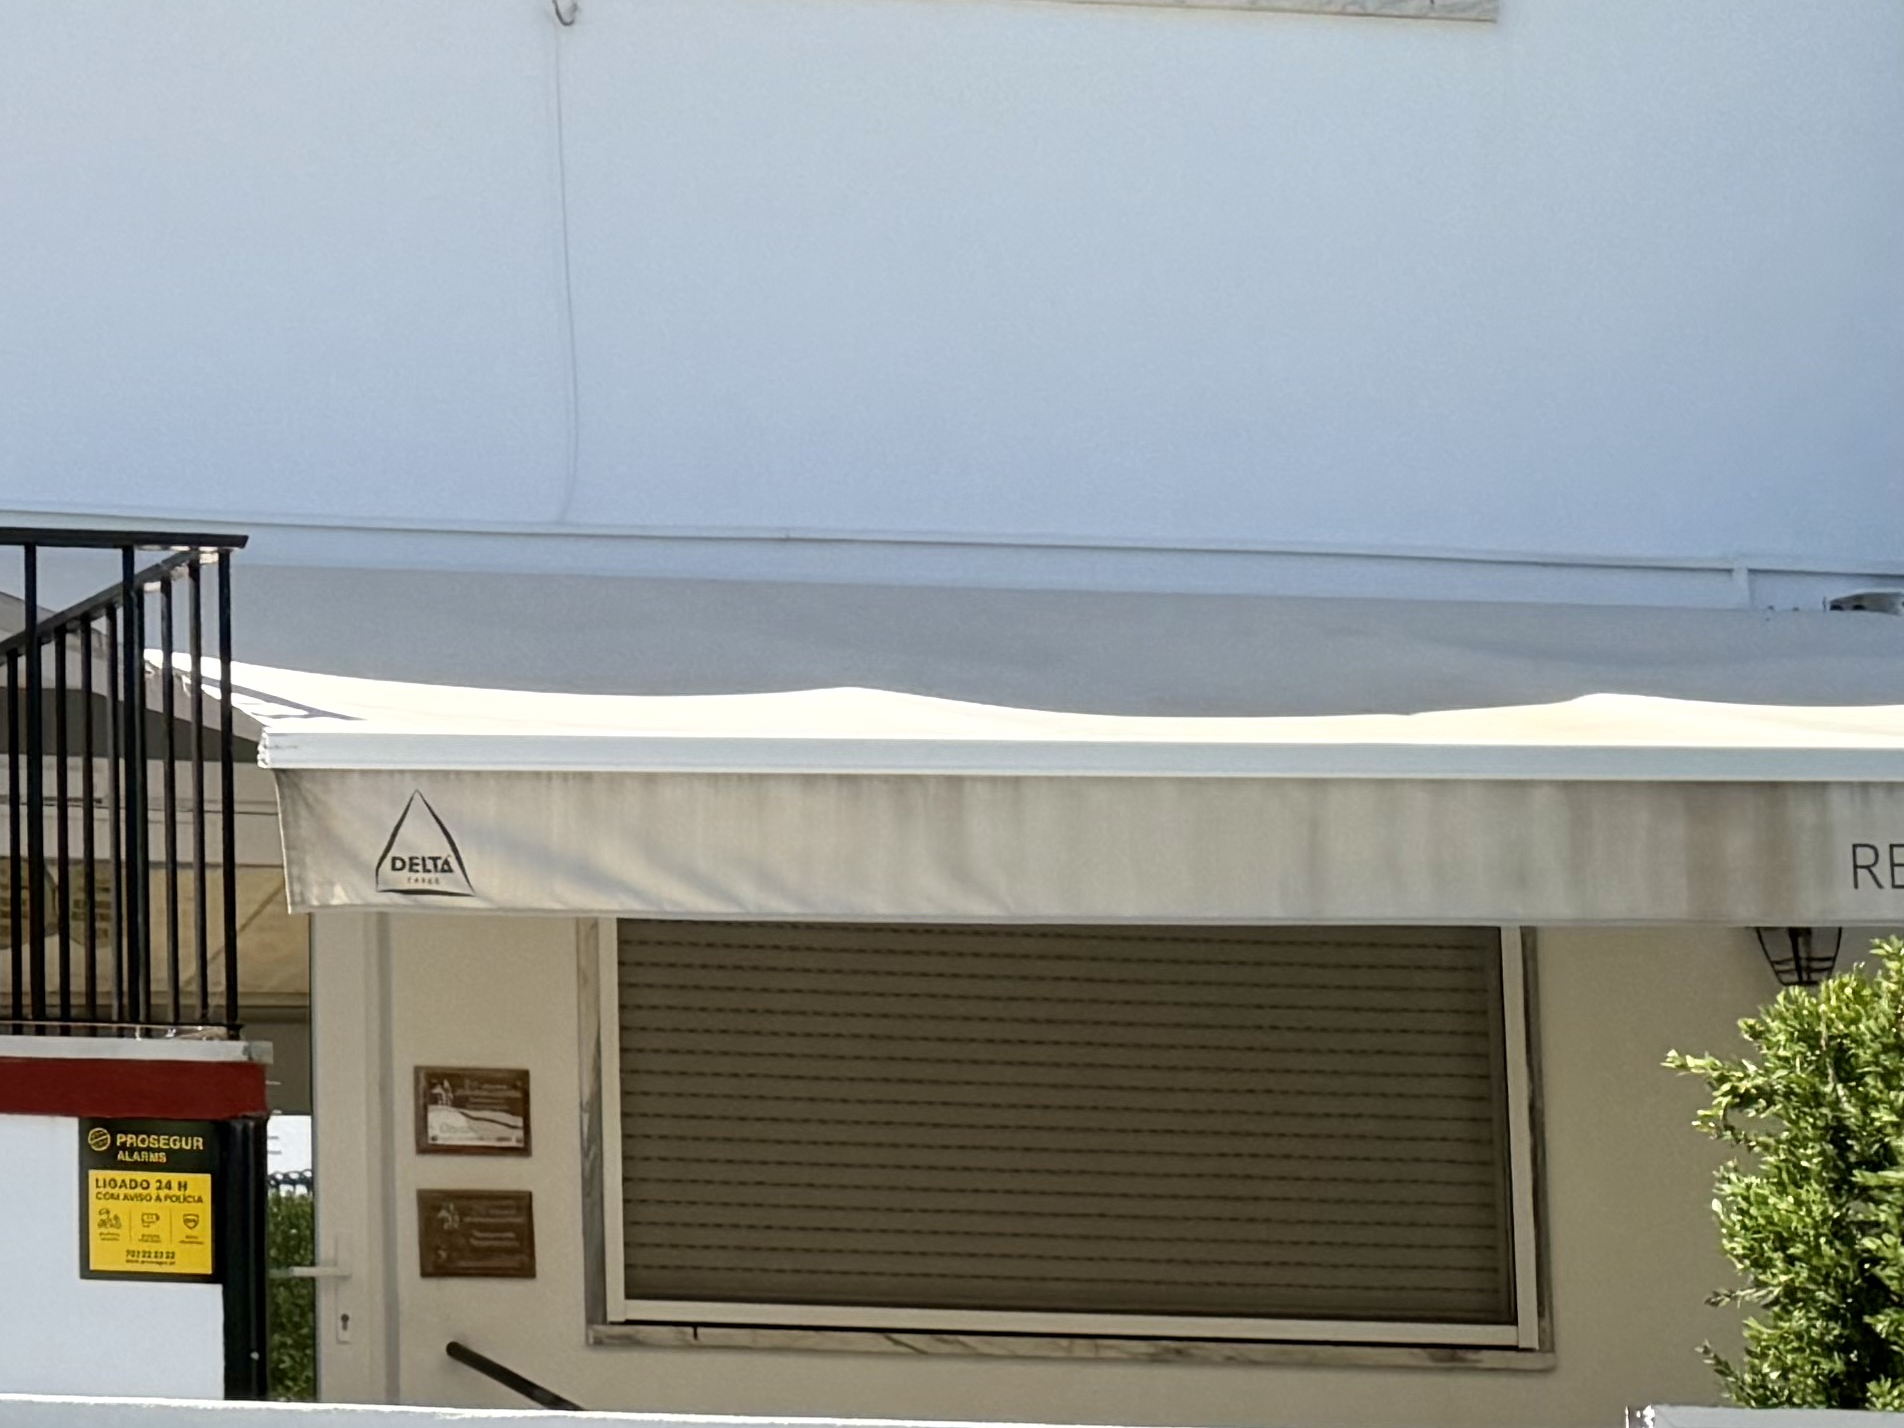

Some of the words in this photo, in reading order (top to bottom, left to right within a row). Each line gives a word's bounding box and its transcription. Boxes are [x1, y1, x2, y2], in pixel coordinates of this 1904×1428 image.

[391, 854, 454, 873] DELTA
[1850, 843, 1904, 890] RE
[116, 1133, 204, 1150] PROSEGUR
[117, 1150, 167, 1163] ALARMS
[95, 1178, 151, 1191] LIGADO
[155, 1179, 172, 1191] 24
[177, 1181, 189, 1192] H
[95, 1192, 121, 1202] COM
[122, 1193, 153, 1203] AVISO
